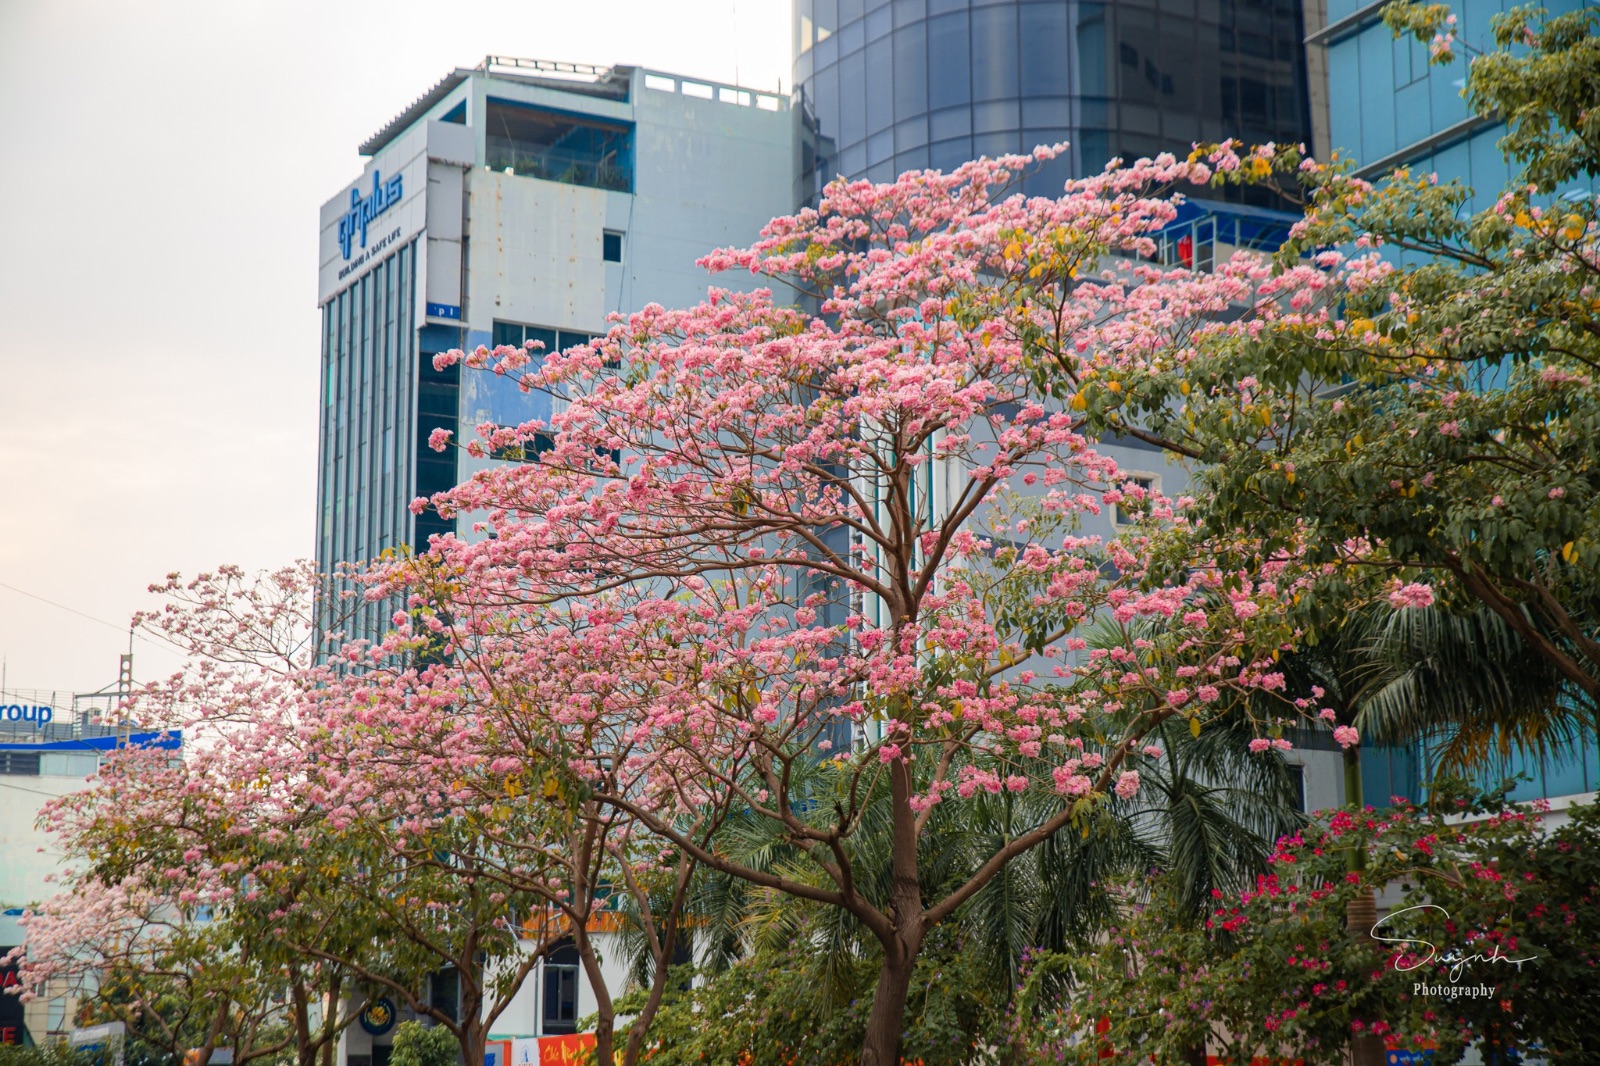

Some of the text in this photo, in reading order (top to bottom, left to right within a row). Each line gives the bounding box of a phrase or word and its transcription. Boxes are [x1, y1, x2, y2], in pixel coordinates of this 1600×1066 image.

[365, 250, 370, 260] A
[371, 237, 387, 256] SAFE
[387, 226, 401, 244] LIFE
